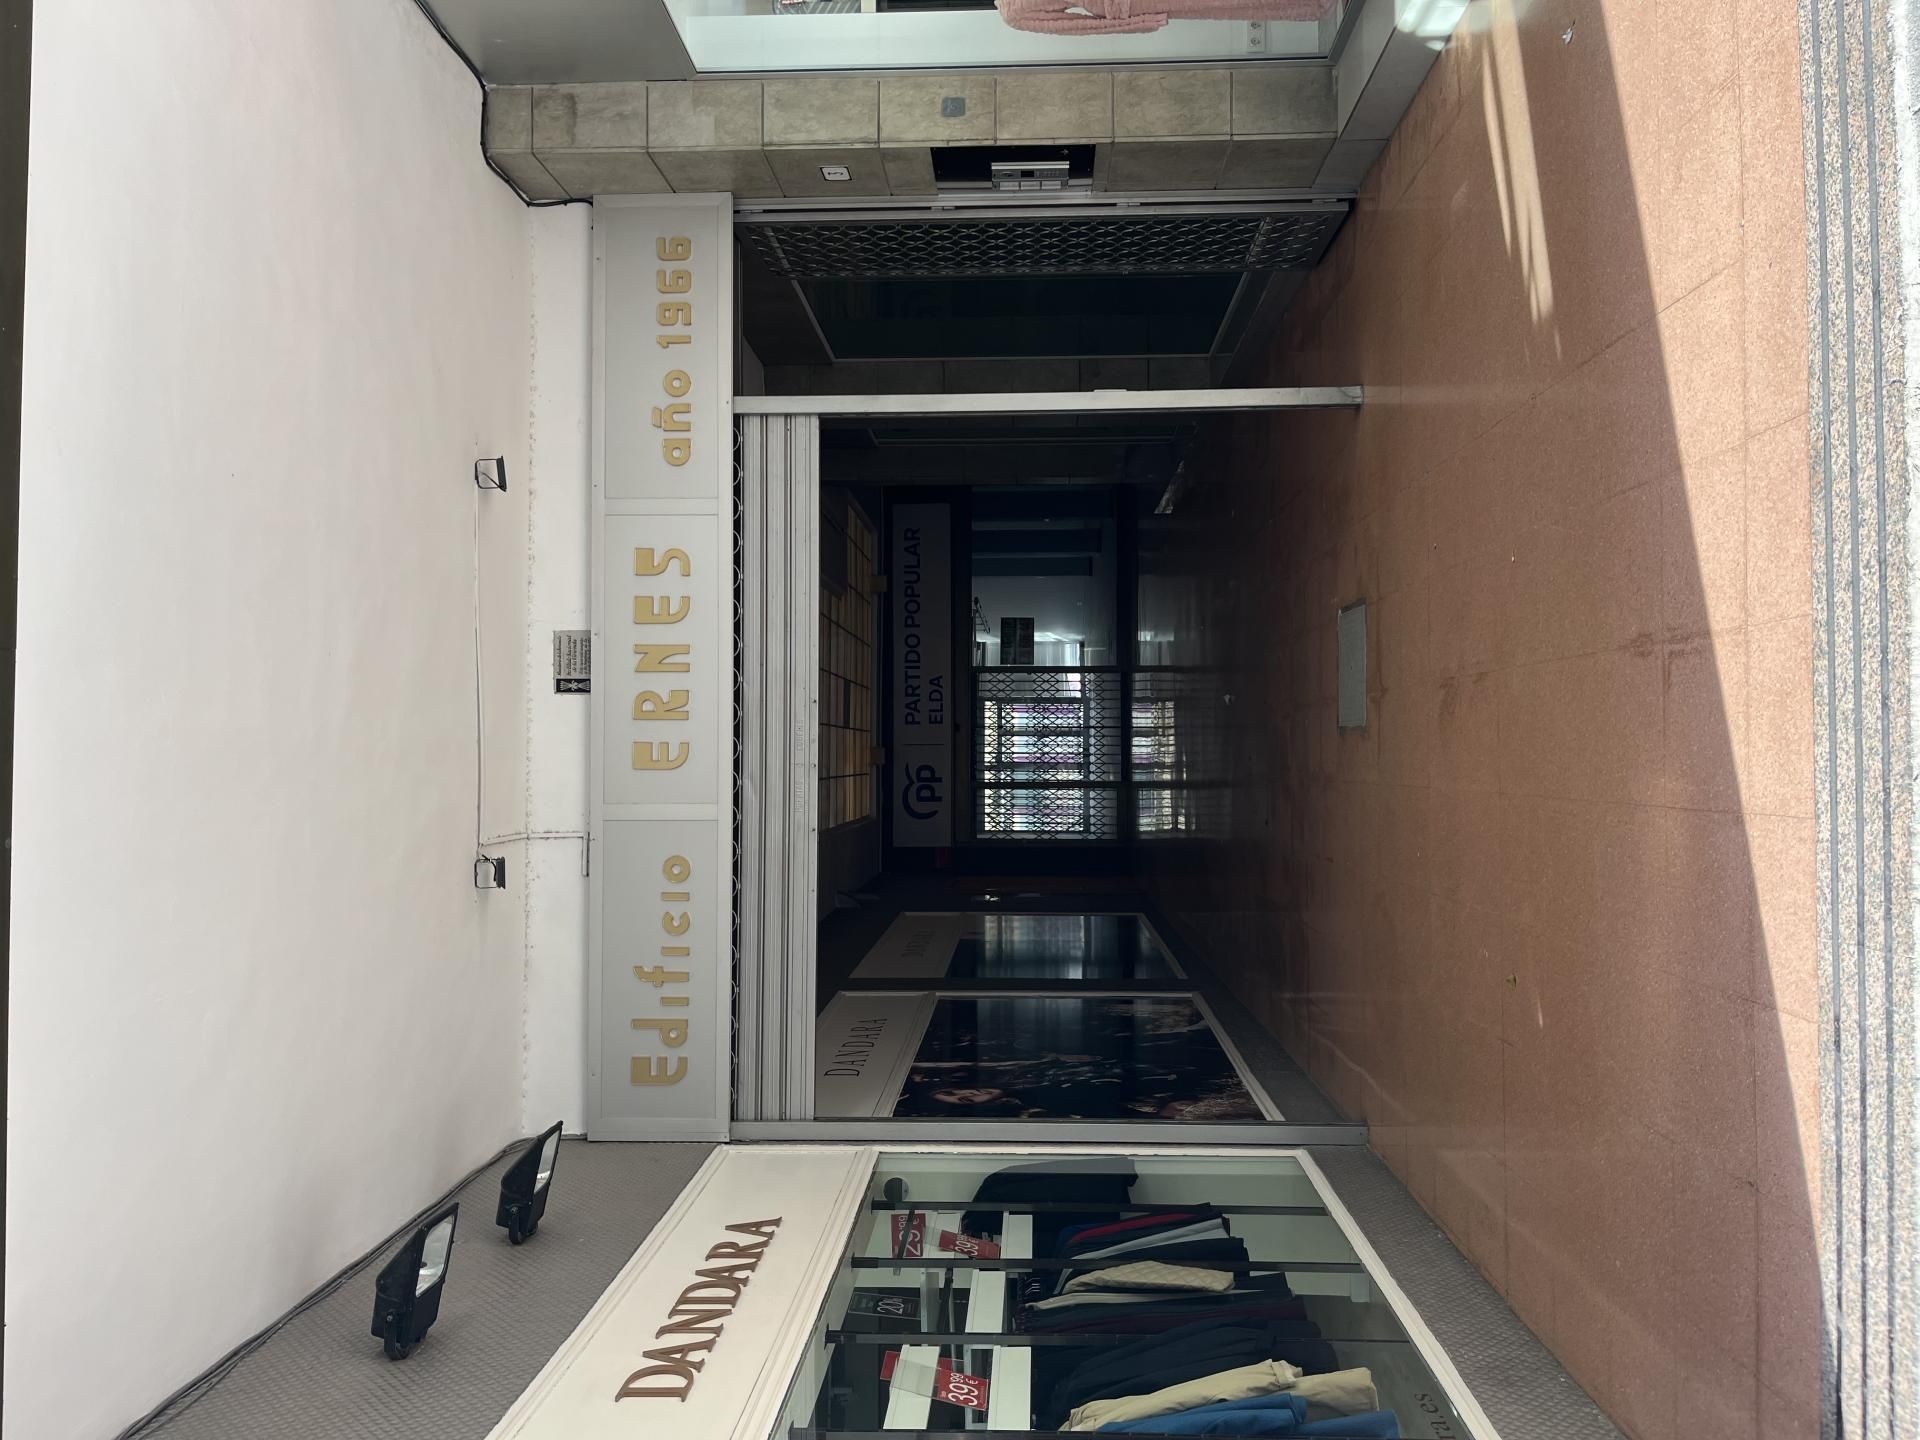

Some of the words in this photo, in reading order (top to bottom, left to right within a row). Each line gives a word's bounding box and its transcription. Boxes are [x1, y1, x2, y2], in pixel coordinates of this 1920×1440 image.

[656, 236, 692, 349] 1966
[651, 370, 692, 467] año
[904, 527, 922, 629] POPULAR
[632, 547, 691, 771] ERNES
[904, 633, 922, 726] PARTIDO
[927, 674, 944, 725] ELDA
[630, 855, 691, 1086] Edificio
[823, 1018, 888, 1077] DANDARA
[614, 1216, 782, 1402] DANDARA
